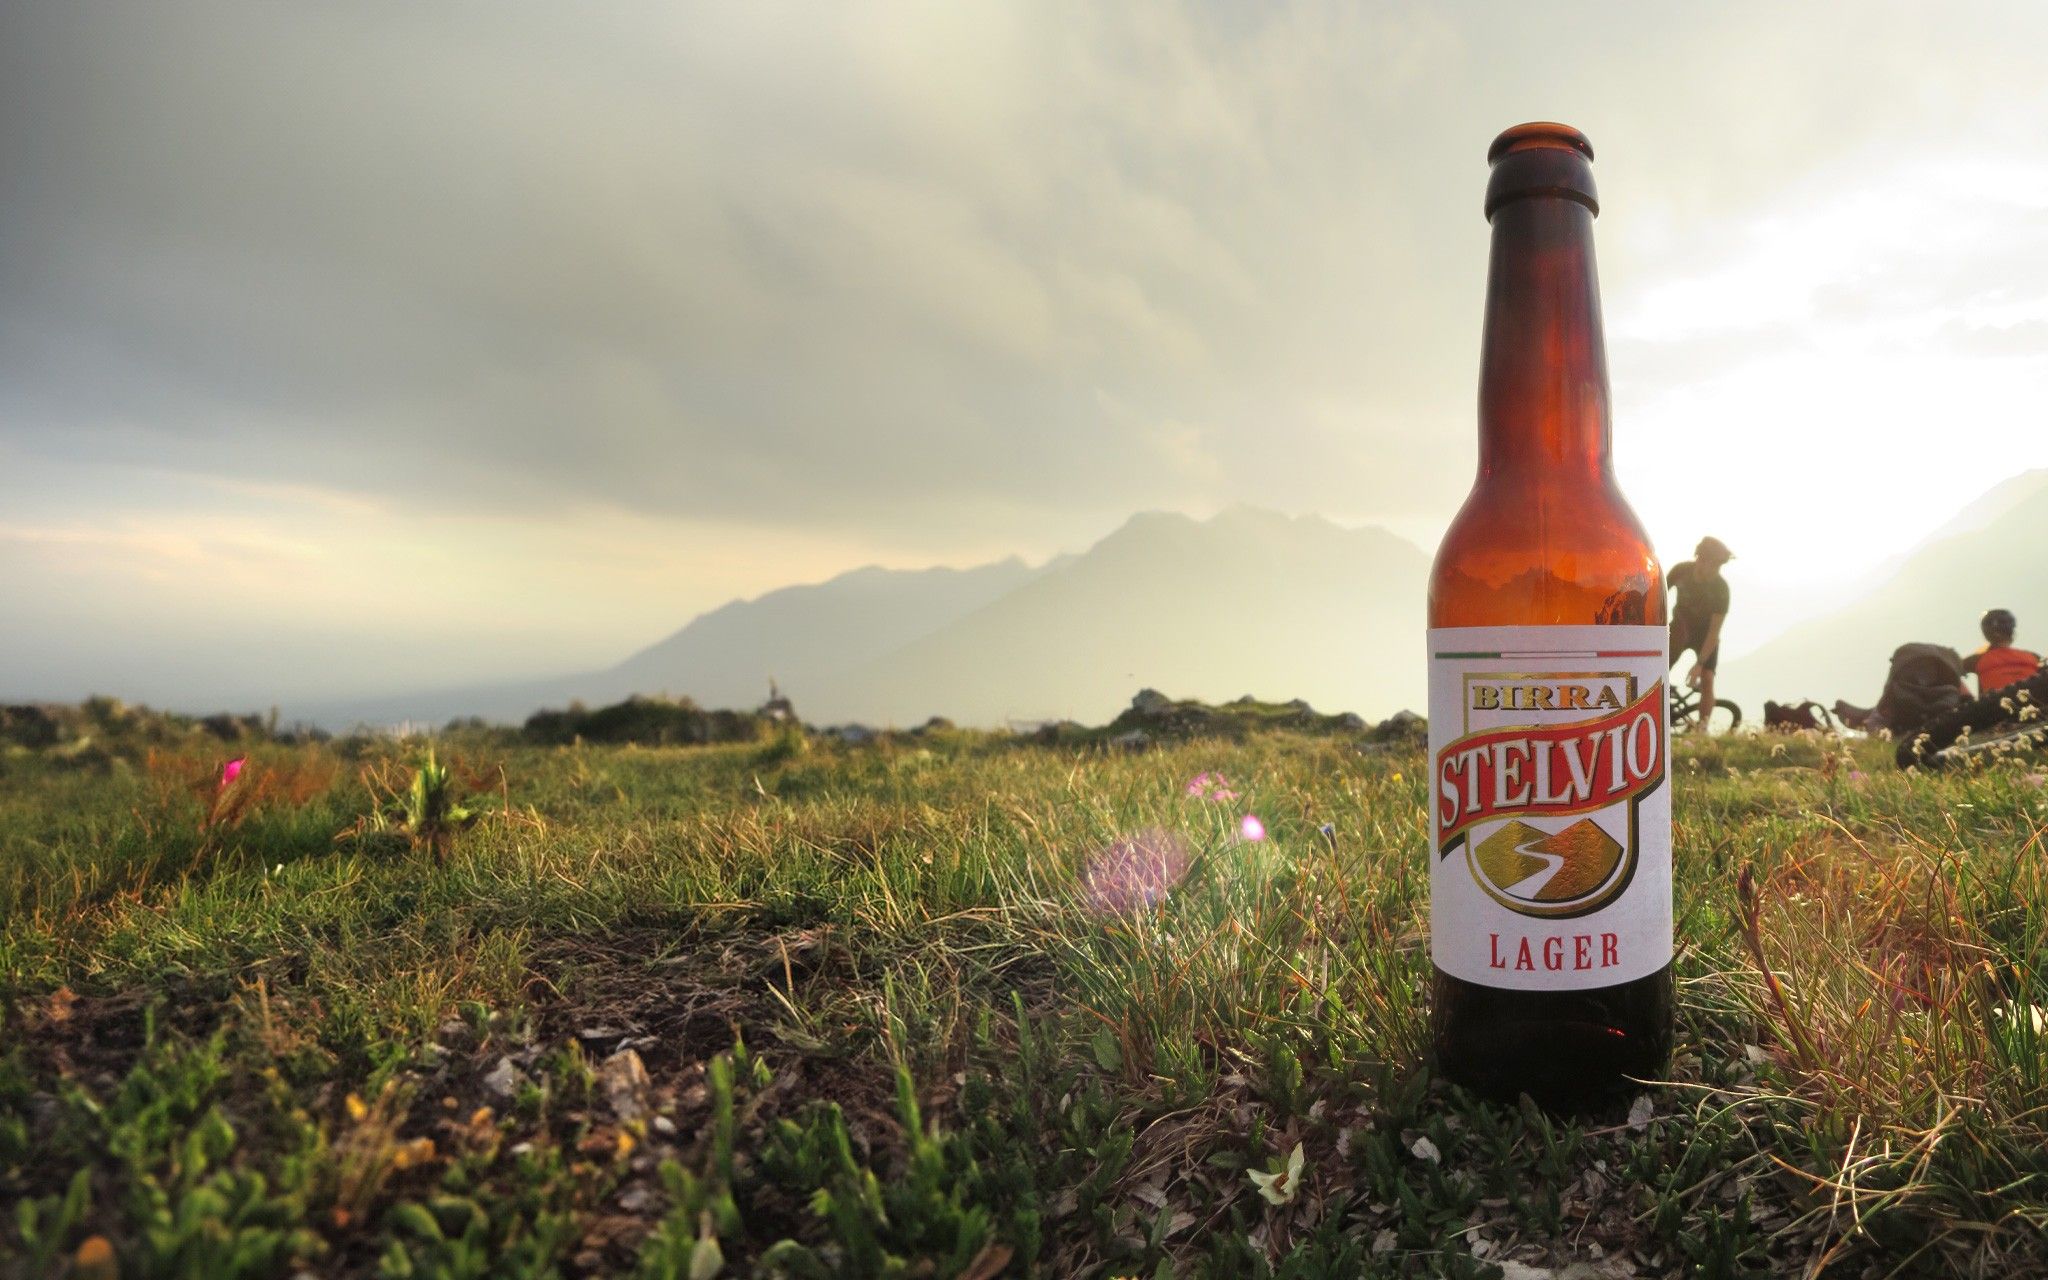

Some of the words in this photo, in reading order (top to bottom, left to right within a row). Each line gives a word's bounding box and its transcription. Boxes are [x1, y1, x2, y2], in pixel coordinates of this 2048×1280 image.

[1472, 685, 1624, 711] BIRRA
[1440, 711, 1658, 829] STELVIO
[1489, 932, 1620, 972] LAGER
